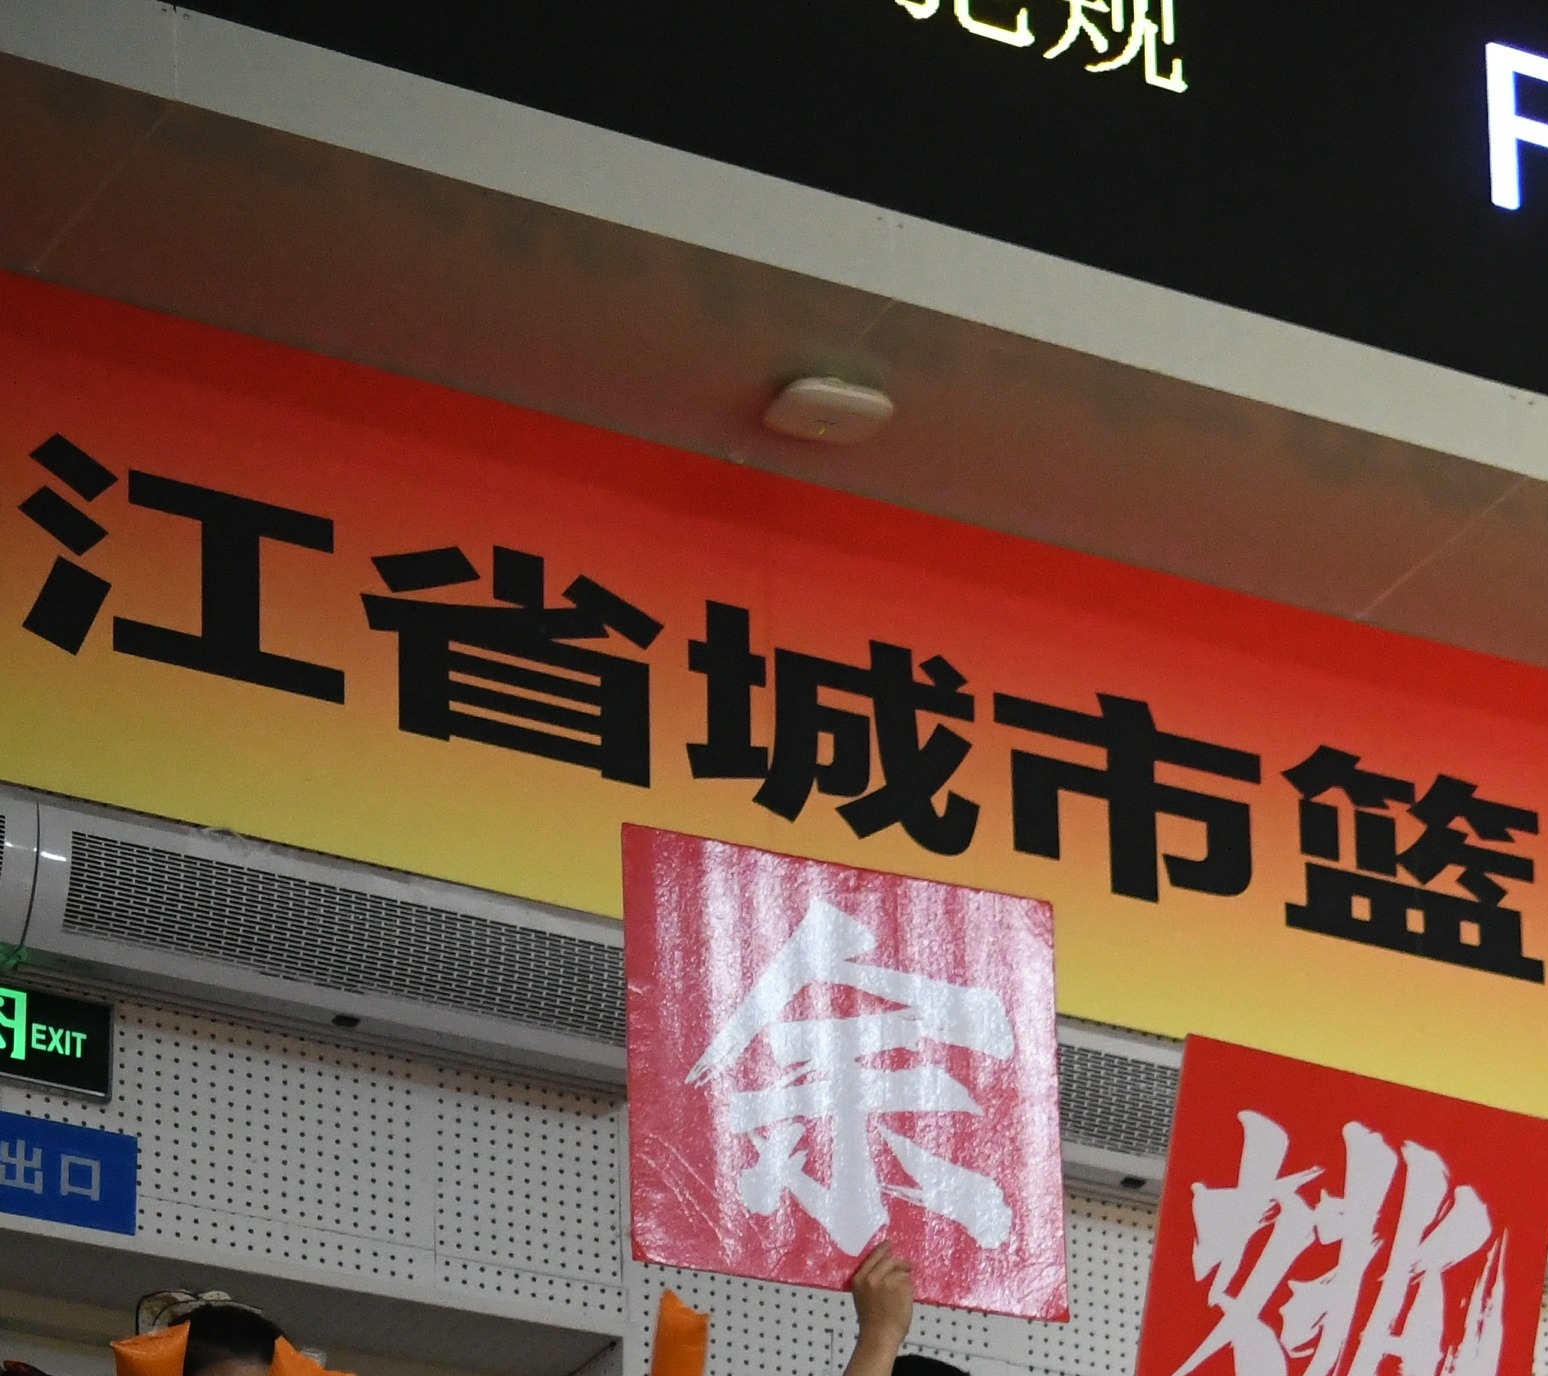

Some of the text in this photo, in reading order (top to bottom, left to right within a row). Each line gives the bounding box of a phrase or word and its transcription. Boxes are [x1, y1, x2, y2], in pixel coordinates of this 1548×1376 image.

[31, 1022, 87, 1058] EXIT
[686, 893, 1015, 1256] 余
[0, 1138, 101, 1201] 出口
